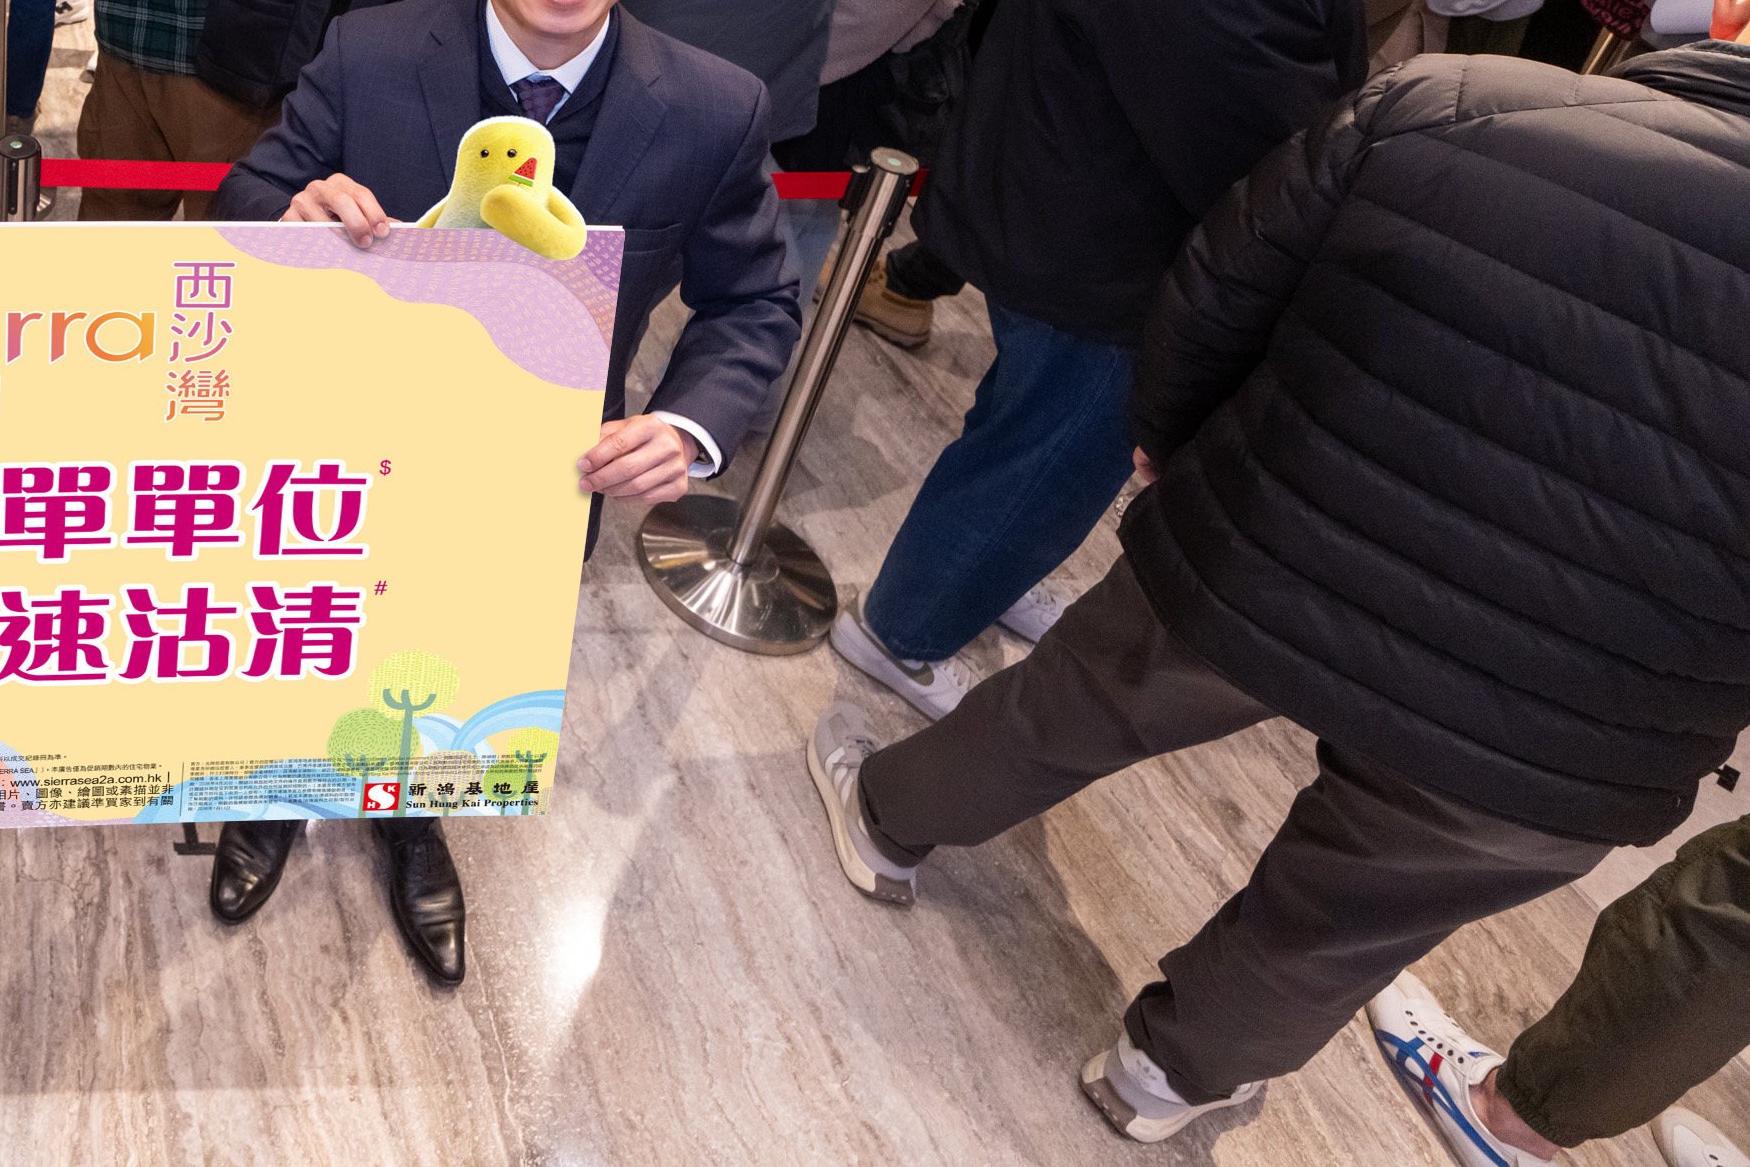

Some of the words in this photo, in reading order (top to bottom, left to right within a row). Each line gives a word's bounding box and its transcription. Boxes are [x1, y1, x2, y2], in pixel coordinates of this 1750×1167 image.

[164, 261, 236, 423] 西沙灣
[379, 459, 392, 476] $
[374, 581, 387, 595] #
[10, 773, 162, 788] www.sierrasea2a.com.hk
[405, 800, 426, 809] Sun
[430, 800, 458, 809] Hung
[462, 799, 481, 808] Kai
[484, 798, 539, 809] Properties
